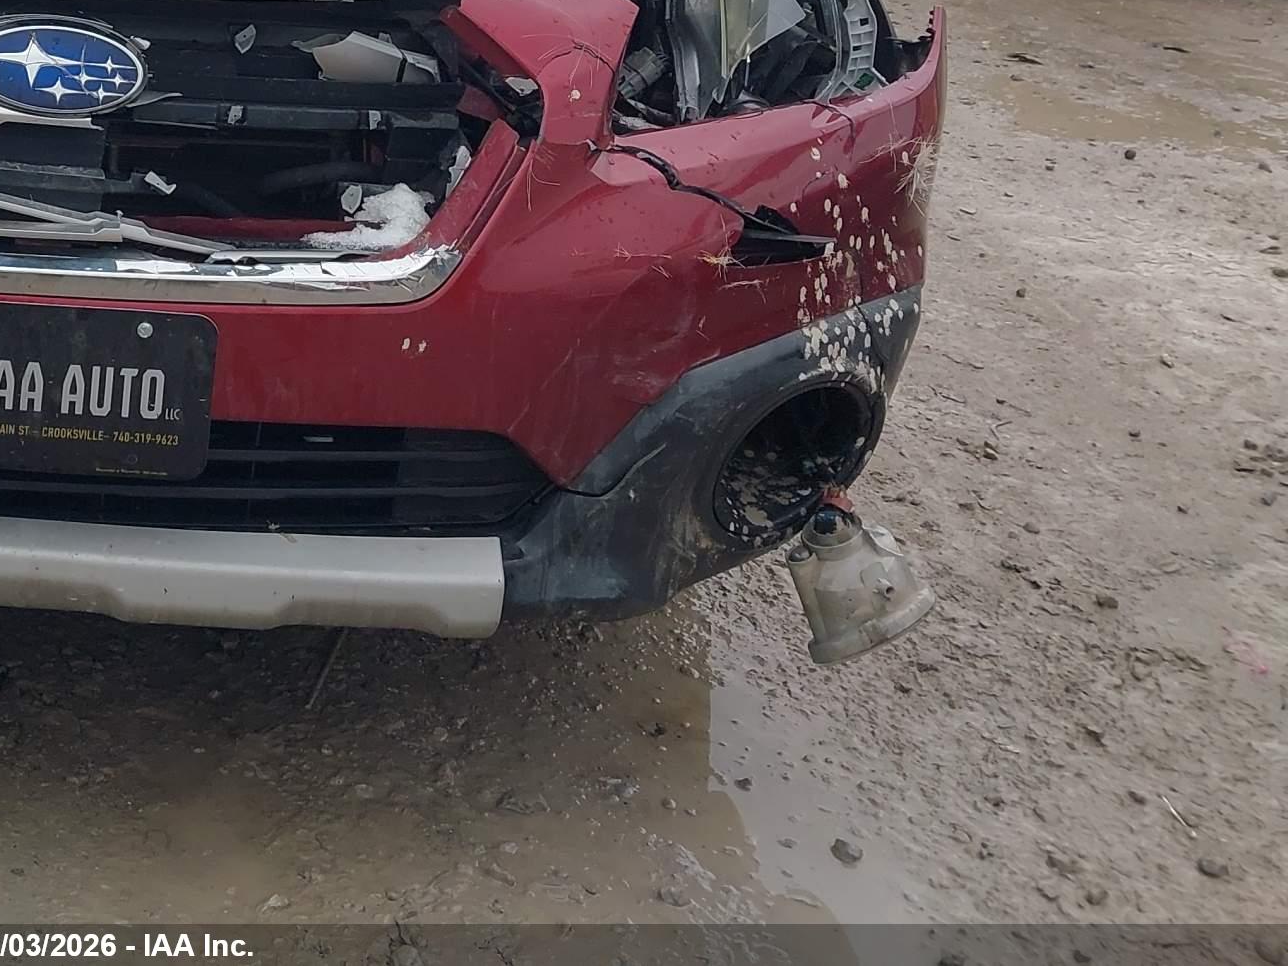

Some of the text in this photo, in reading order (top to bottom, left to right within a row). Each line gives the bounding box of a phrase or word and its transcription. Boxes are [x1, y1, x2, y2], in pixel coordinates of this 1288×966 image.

[61, 364, 165, 419] AUTO
[19, 425, 29, 435] ST
[113, 431, 179, 446] 740-319-9623
